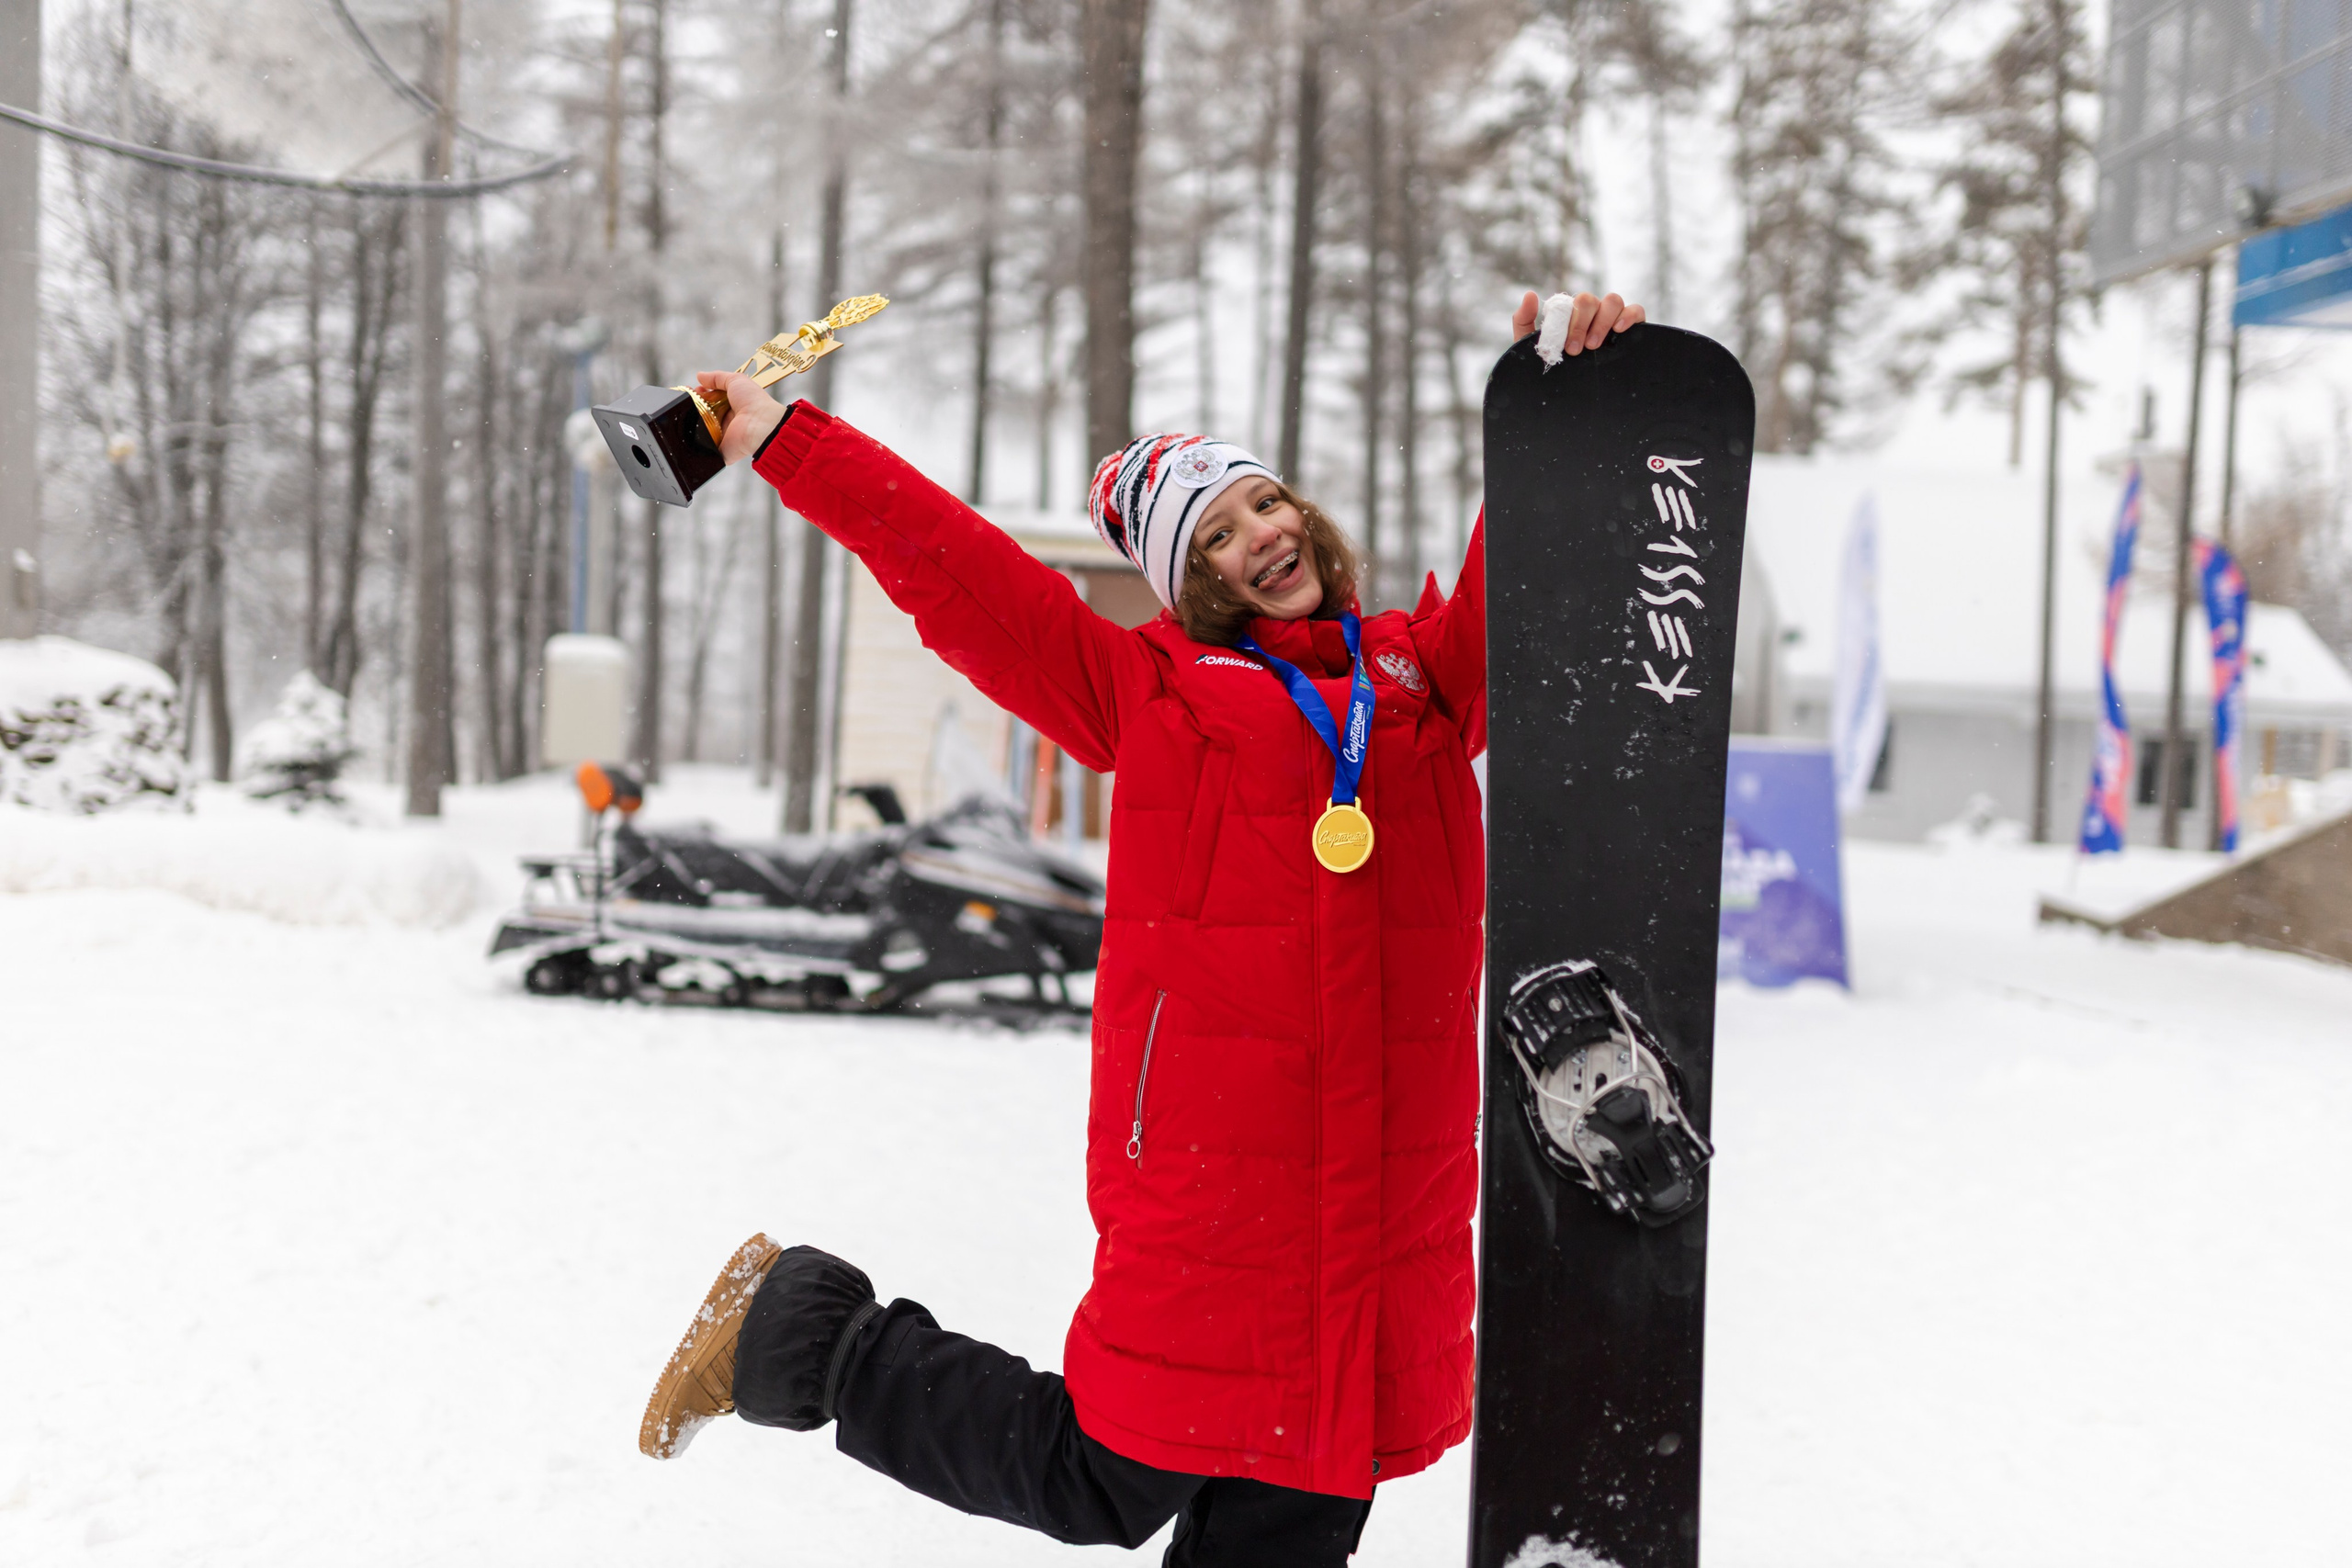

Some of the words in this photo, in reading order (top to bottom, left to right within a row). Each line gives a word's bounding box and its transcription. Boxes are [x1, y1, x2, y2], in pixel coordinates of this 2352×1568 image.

[1636, 455, 1705, 704] KESSLER
[1194, 653, 1264, 671] FORWARD
[1342, 700, 1365, 763] Спартакиада
